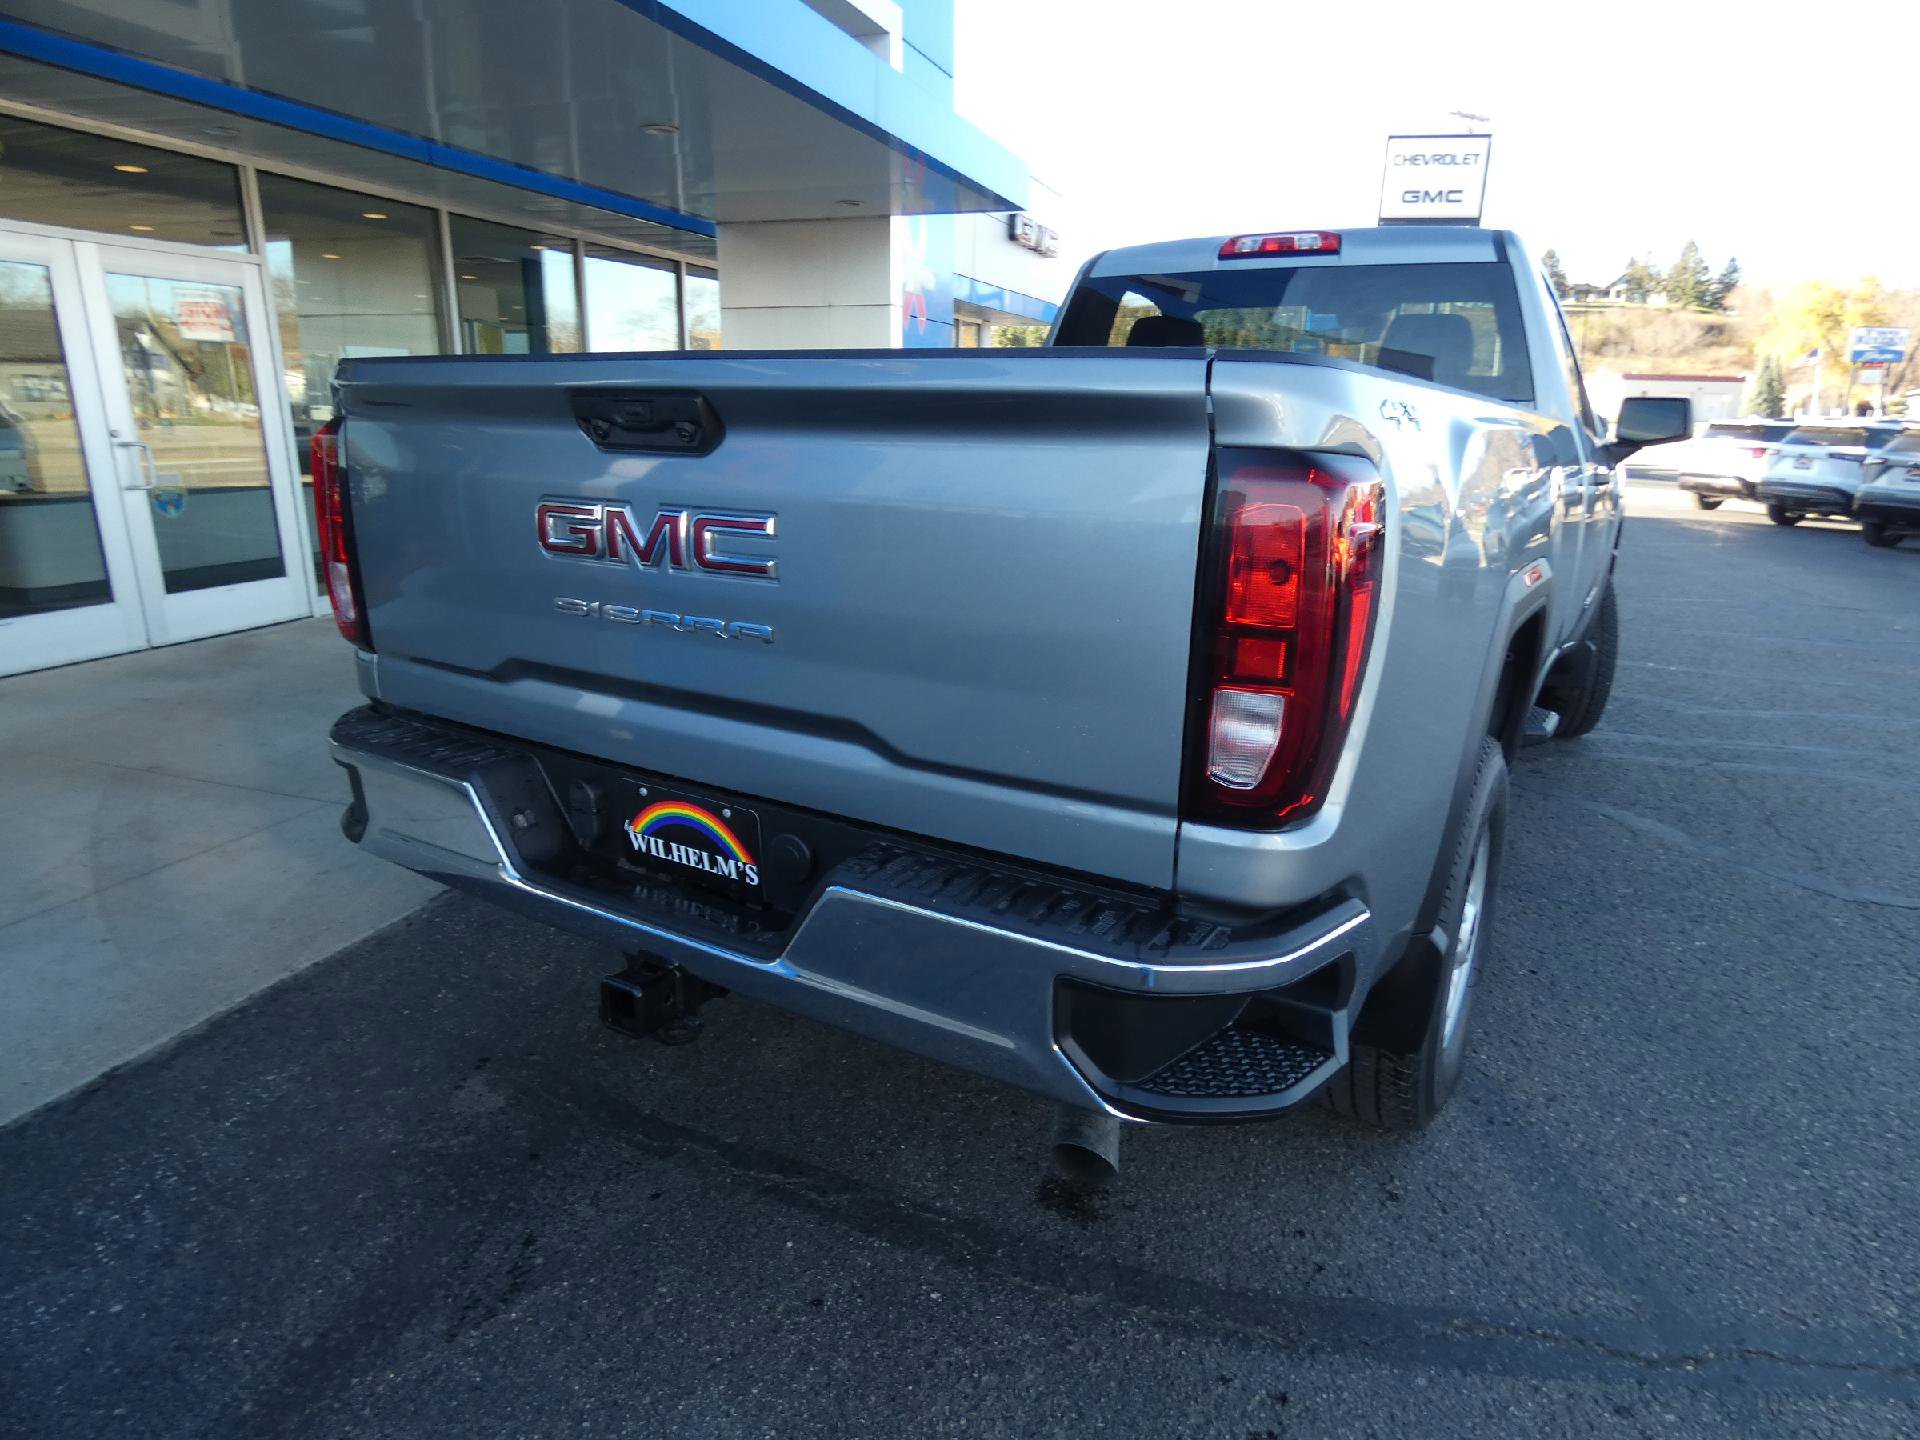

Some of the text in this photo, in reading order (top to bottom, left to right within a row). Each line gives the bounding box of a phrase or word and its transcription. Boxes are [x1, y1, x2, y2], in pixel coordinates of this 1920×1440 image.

[1393, 153, 1481, 166] CHEVROLET
[1401, 189, 1464, 203] GMC
[536, 500, 778, 581] GMC
[553, 597, 775, 643] SIERRA
[625, 824, 760, 886] WILHELM'S
